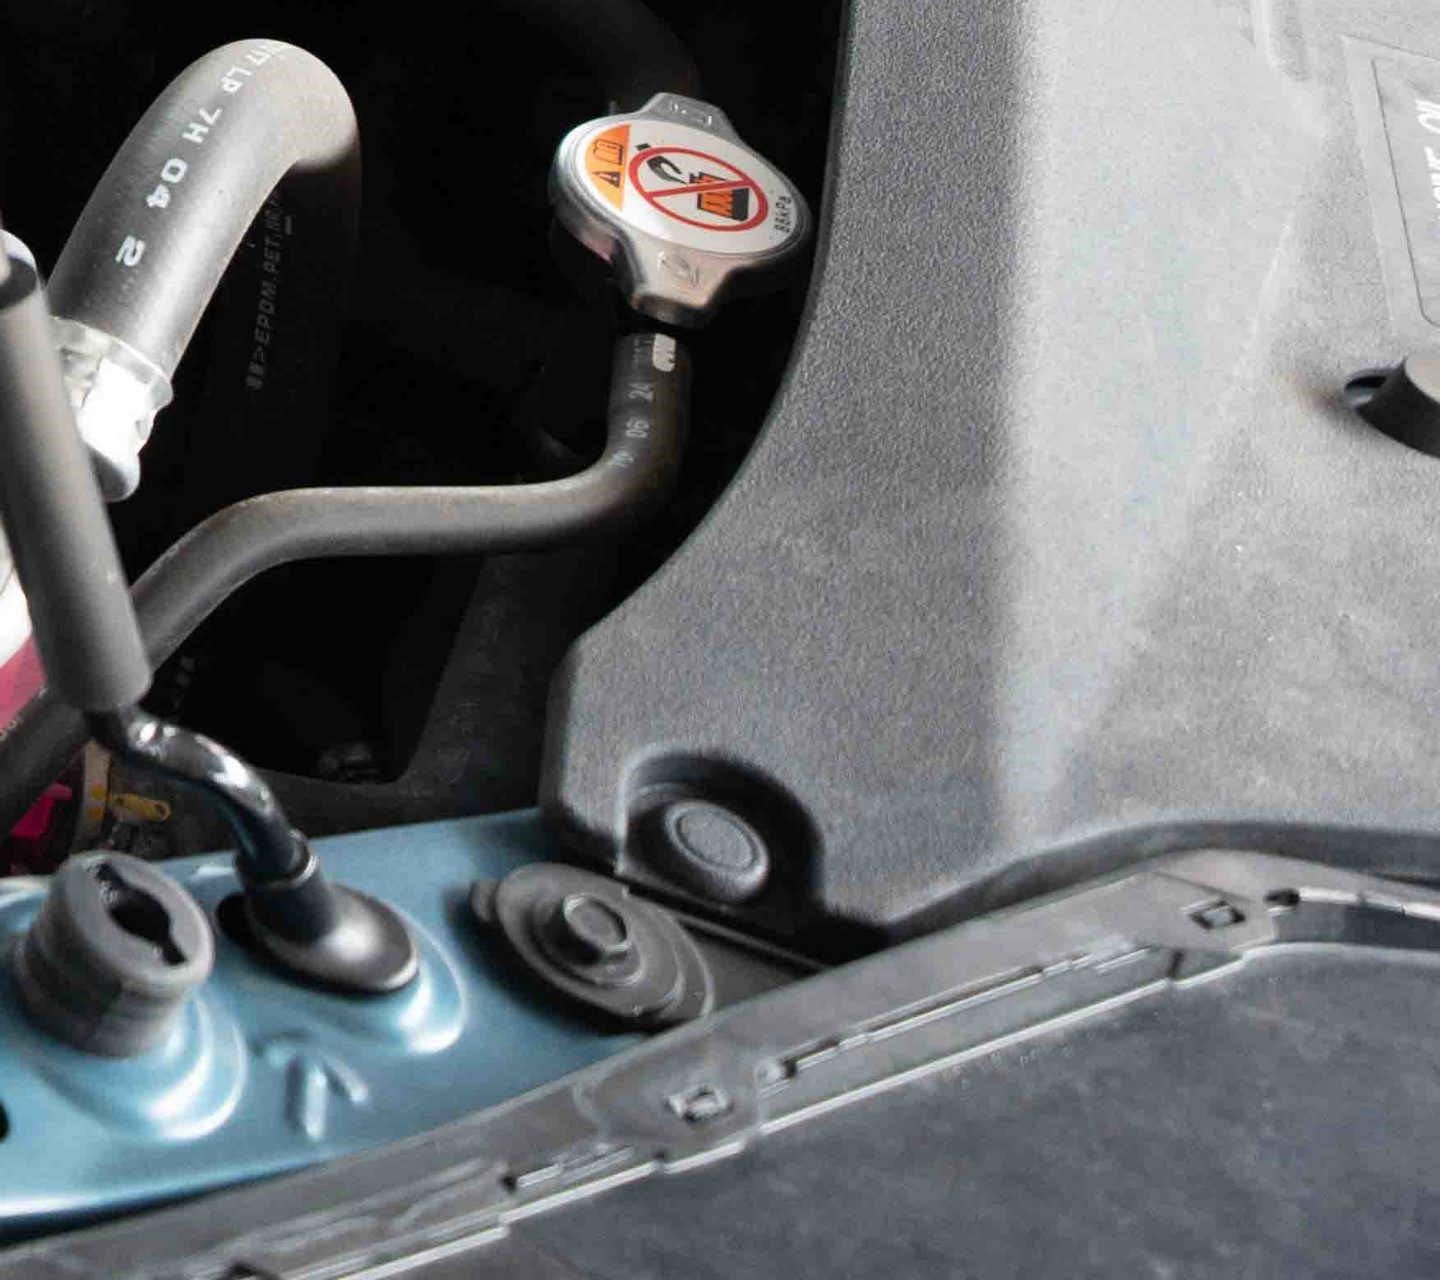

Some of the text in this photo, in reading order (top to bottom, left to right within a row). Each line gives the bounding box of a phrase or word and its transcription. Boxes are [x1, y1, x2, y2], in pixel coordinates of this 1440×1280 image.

[182, 108, 223, 144] 7H
[146, 158, 188, 209] 04
[115, 235, 146, 267] 2
